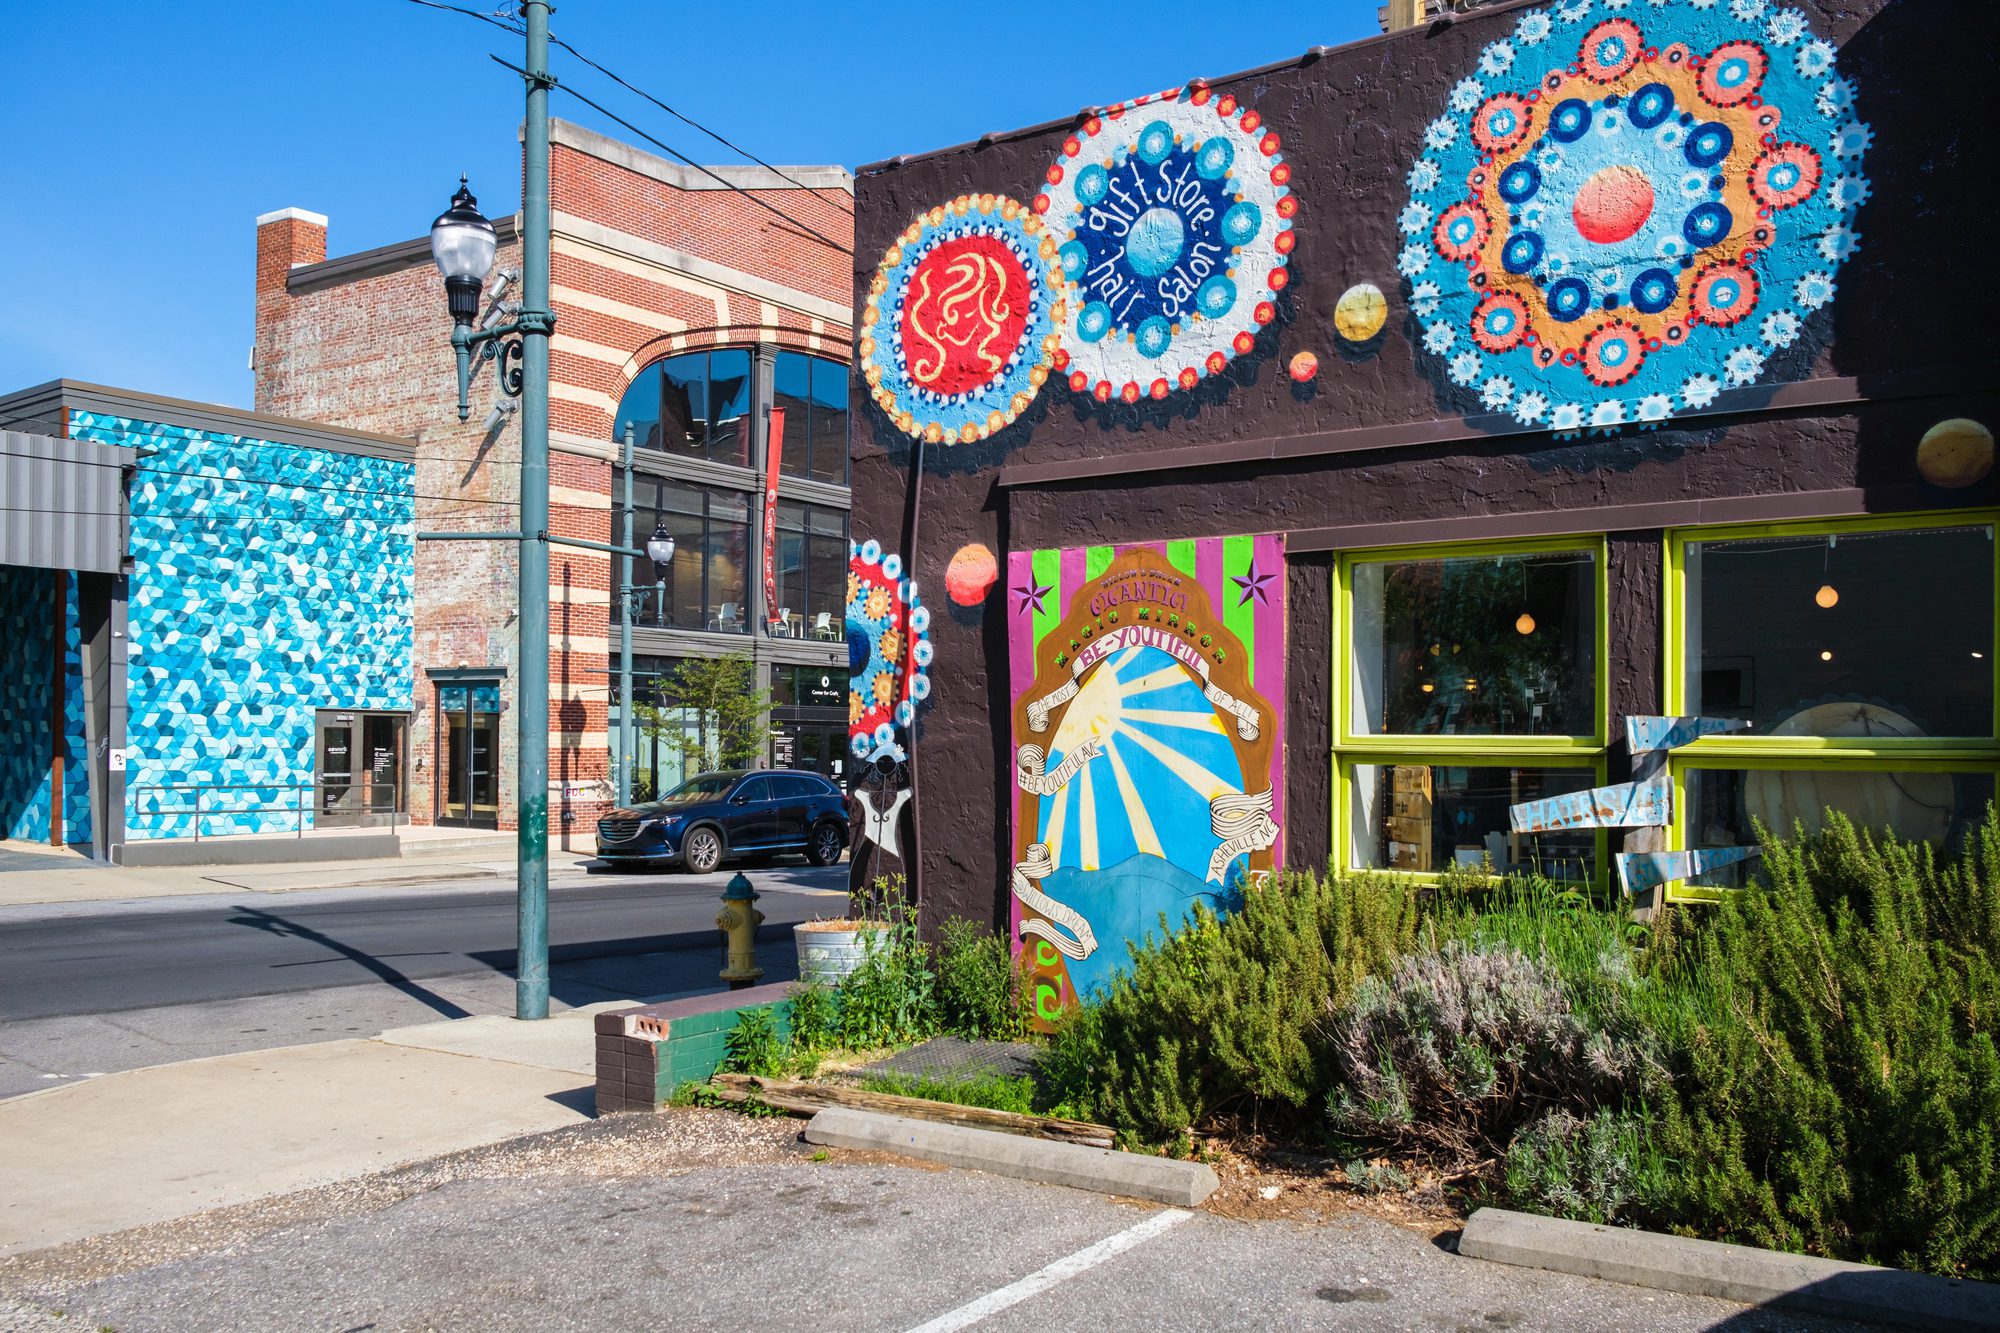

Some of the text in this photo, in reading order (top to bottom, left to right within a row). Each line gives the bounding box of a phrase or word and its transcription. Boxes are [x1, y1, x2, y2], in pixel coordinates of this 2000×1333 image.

[1089, 161, 1152, 237] gift
[1087, 241, 1222, 322] hair Salon
[766, 507, 776, 611] Center for Craft
[1054, 607, 1226, 669] MAGIC MIRROR
[1079, 625, 1202, 672] BE-YOUTIFUL
[1037, 686, 1070, 712] THE MOST
[1213, 690, 1228, 703] OF
[1259, 819, 1275, 842] NC
[1526, 794, 1599, 832] HAIR
